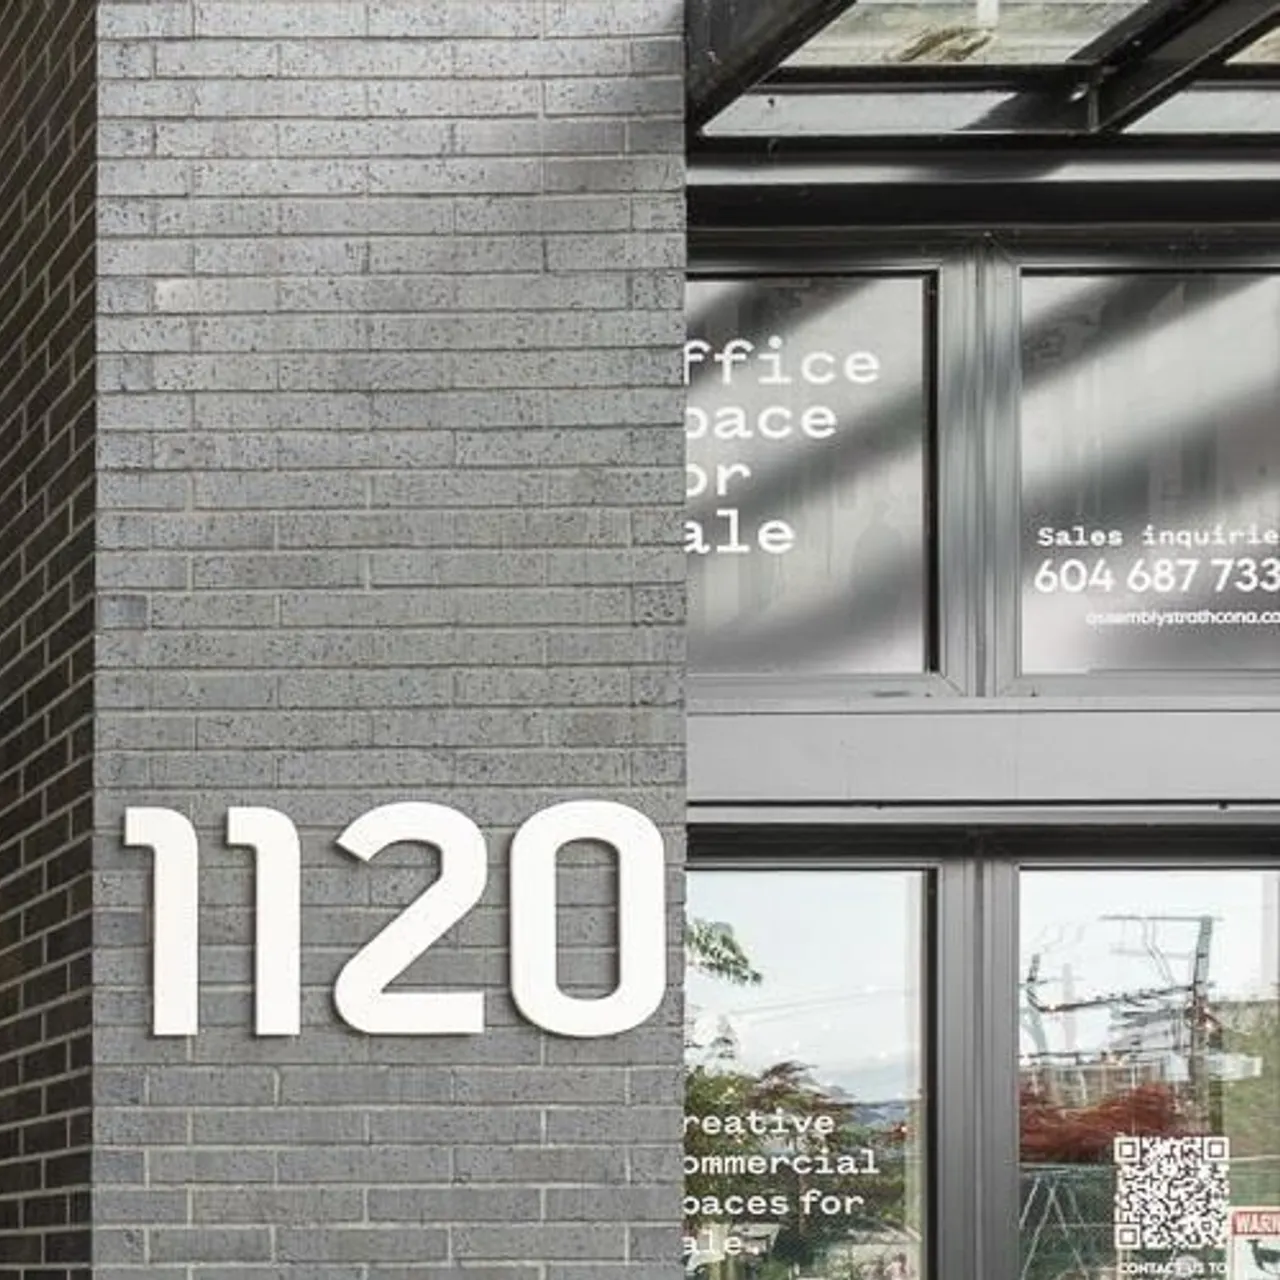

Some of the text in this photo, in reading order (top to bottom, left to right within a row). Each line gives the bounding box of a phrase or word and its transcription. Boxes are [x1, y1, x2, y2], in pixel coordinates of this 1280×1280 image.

[683, 508, 795, 554] ale
[1036, 525, 1124, 547] Sales
[1034, 558, 1280, 594] 604 687 733
[124, 799, 666, 1037] 1120
[683, 1107, 836, 1135] reative
[800, 1188, 865, 1216] for
